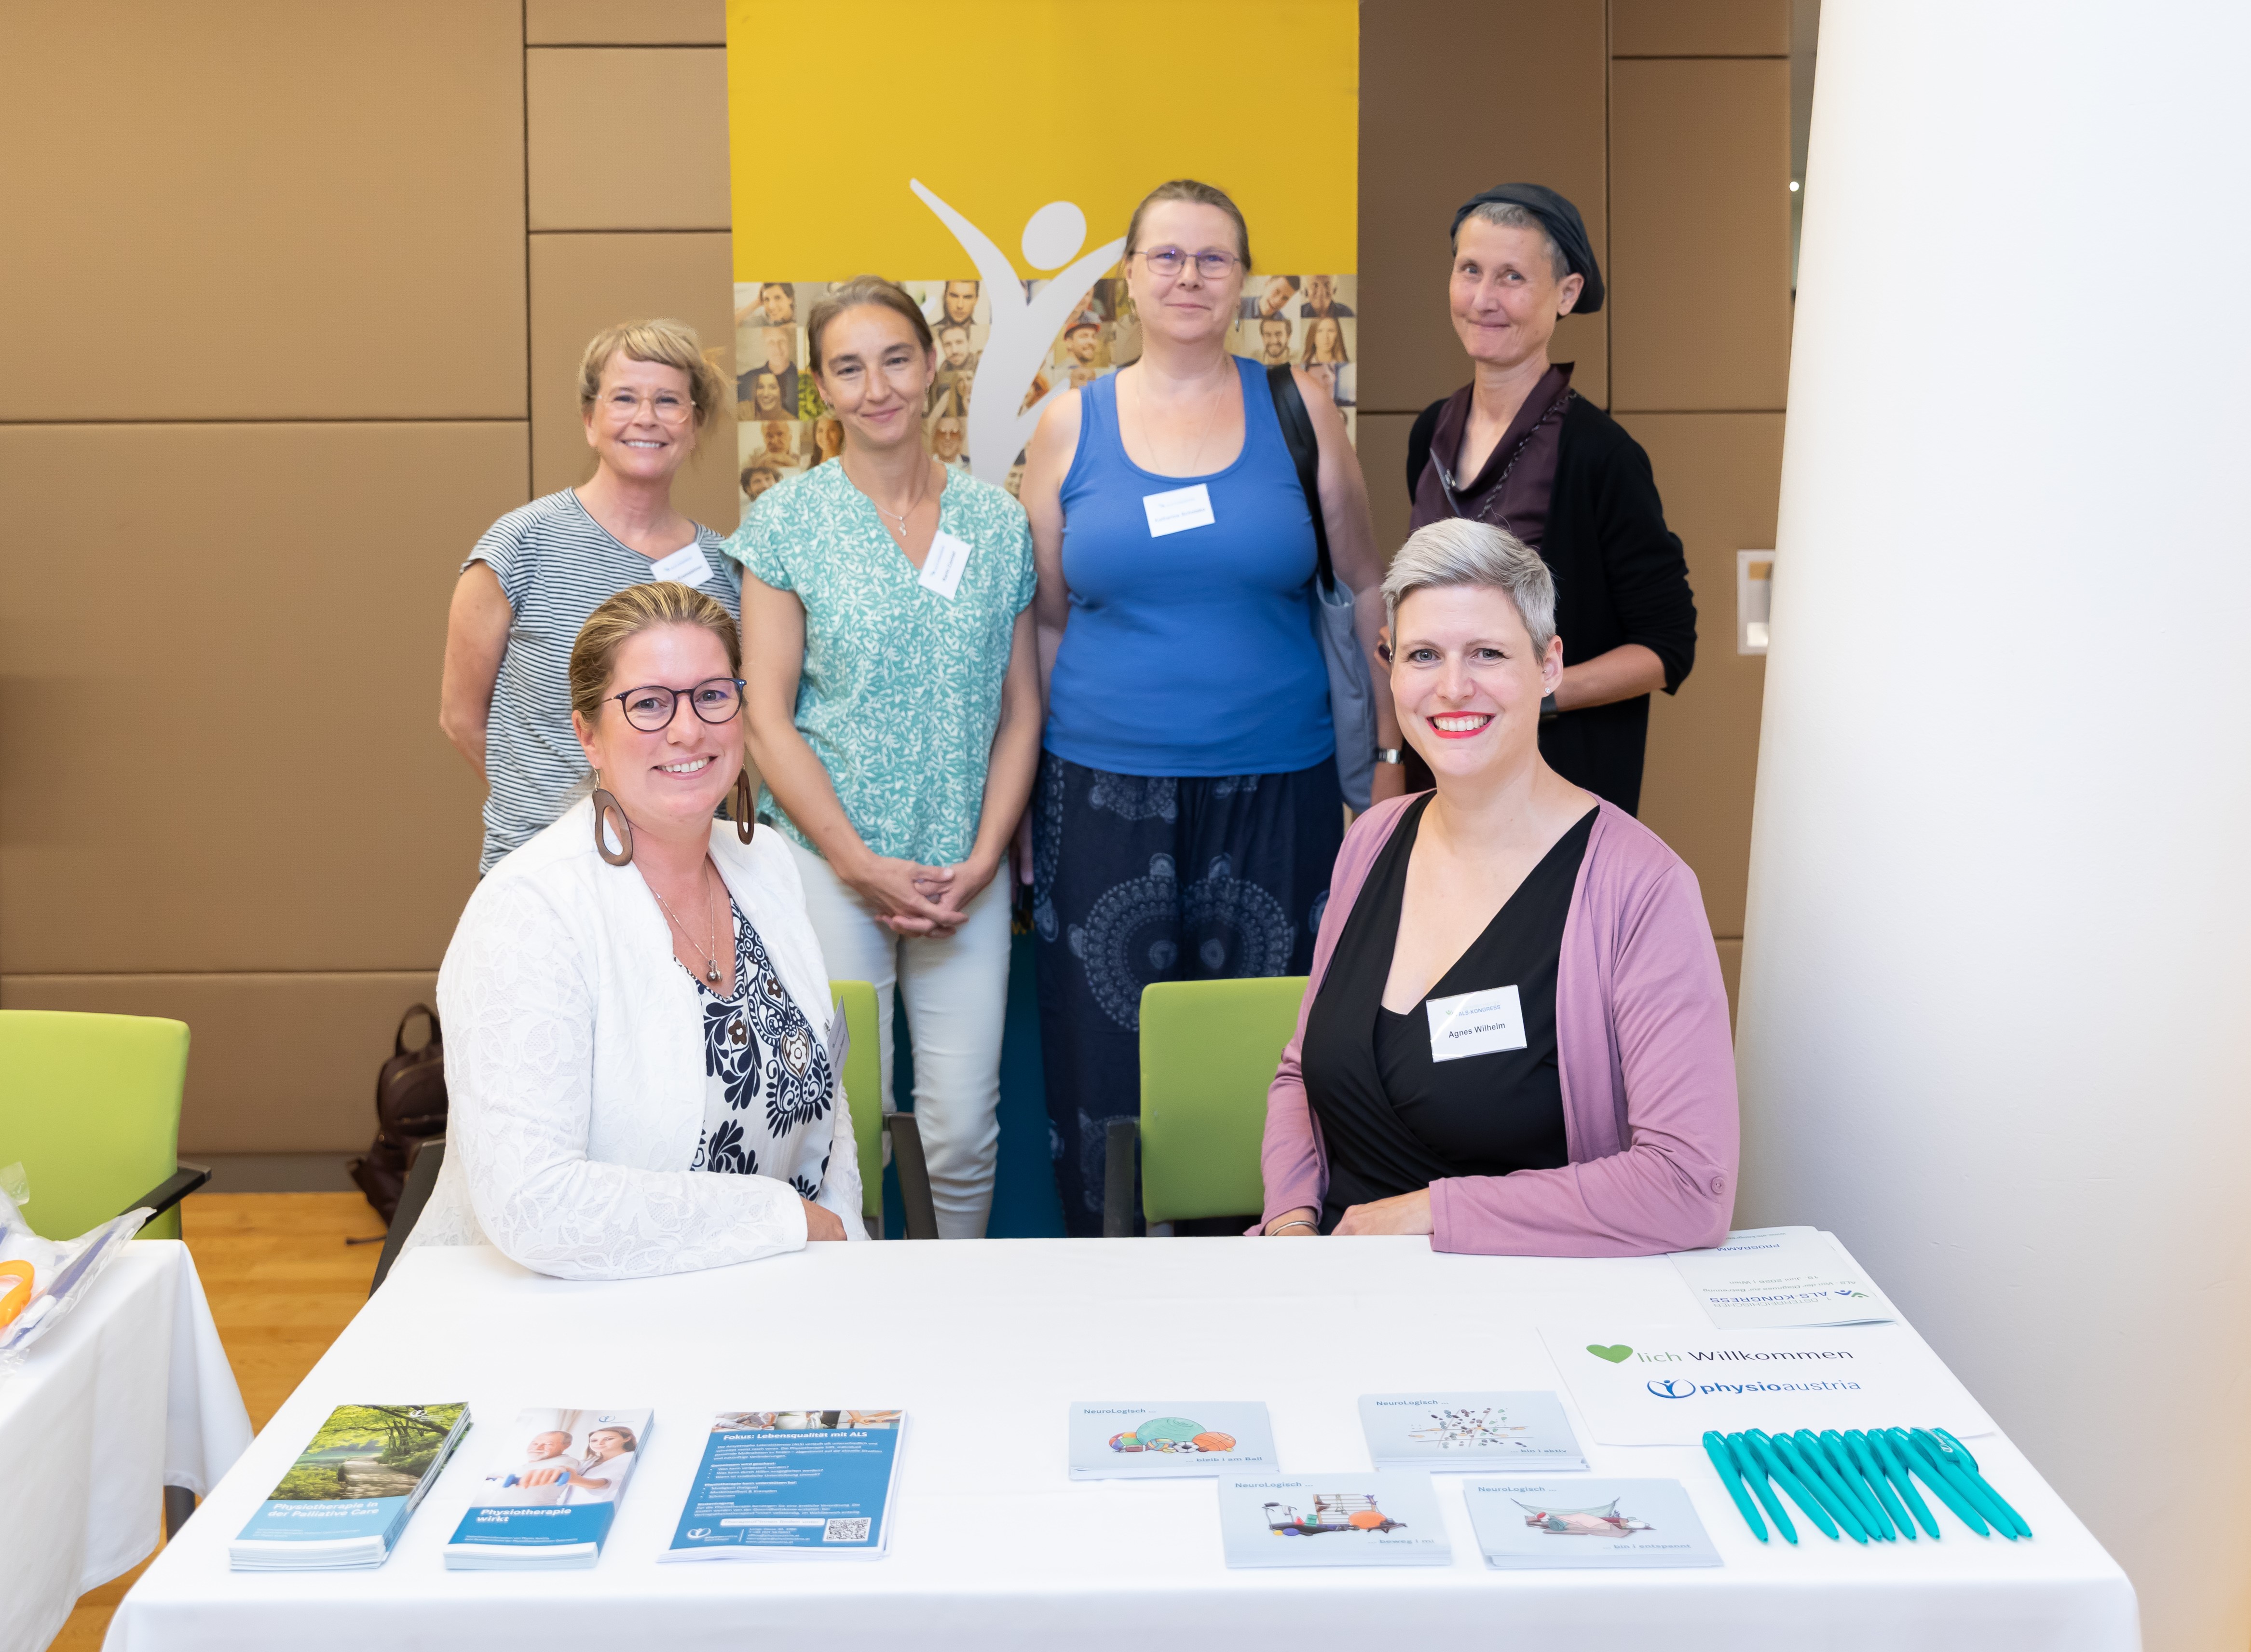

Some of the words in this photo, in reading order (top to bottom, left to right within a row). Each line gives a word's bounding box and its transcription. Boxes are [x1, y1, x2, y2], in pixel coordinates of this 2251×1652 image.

[1459, 1005, 1501, 1016] ALS-KONGRESS
[1449, 1028, 1473, 1038] Agnes
[1474, 1023, 1505, 1033] Wilhelm
[1710, 1291, 1827, 1303] ALS-KONGRESS
[1637, 1352, 1682, 1363] lich
[1687, 1350, 1854, 1361] Willkommen
[1699, 1379, 1861, 1394] physioaustria
[273, 1502, 364, 1511] Physiotherapie
[481, 1508, 572, 1516] Physiotherapie
